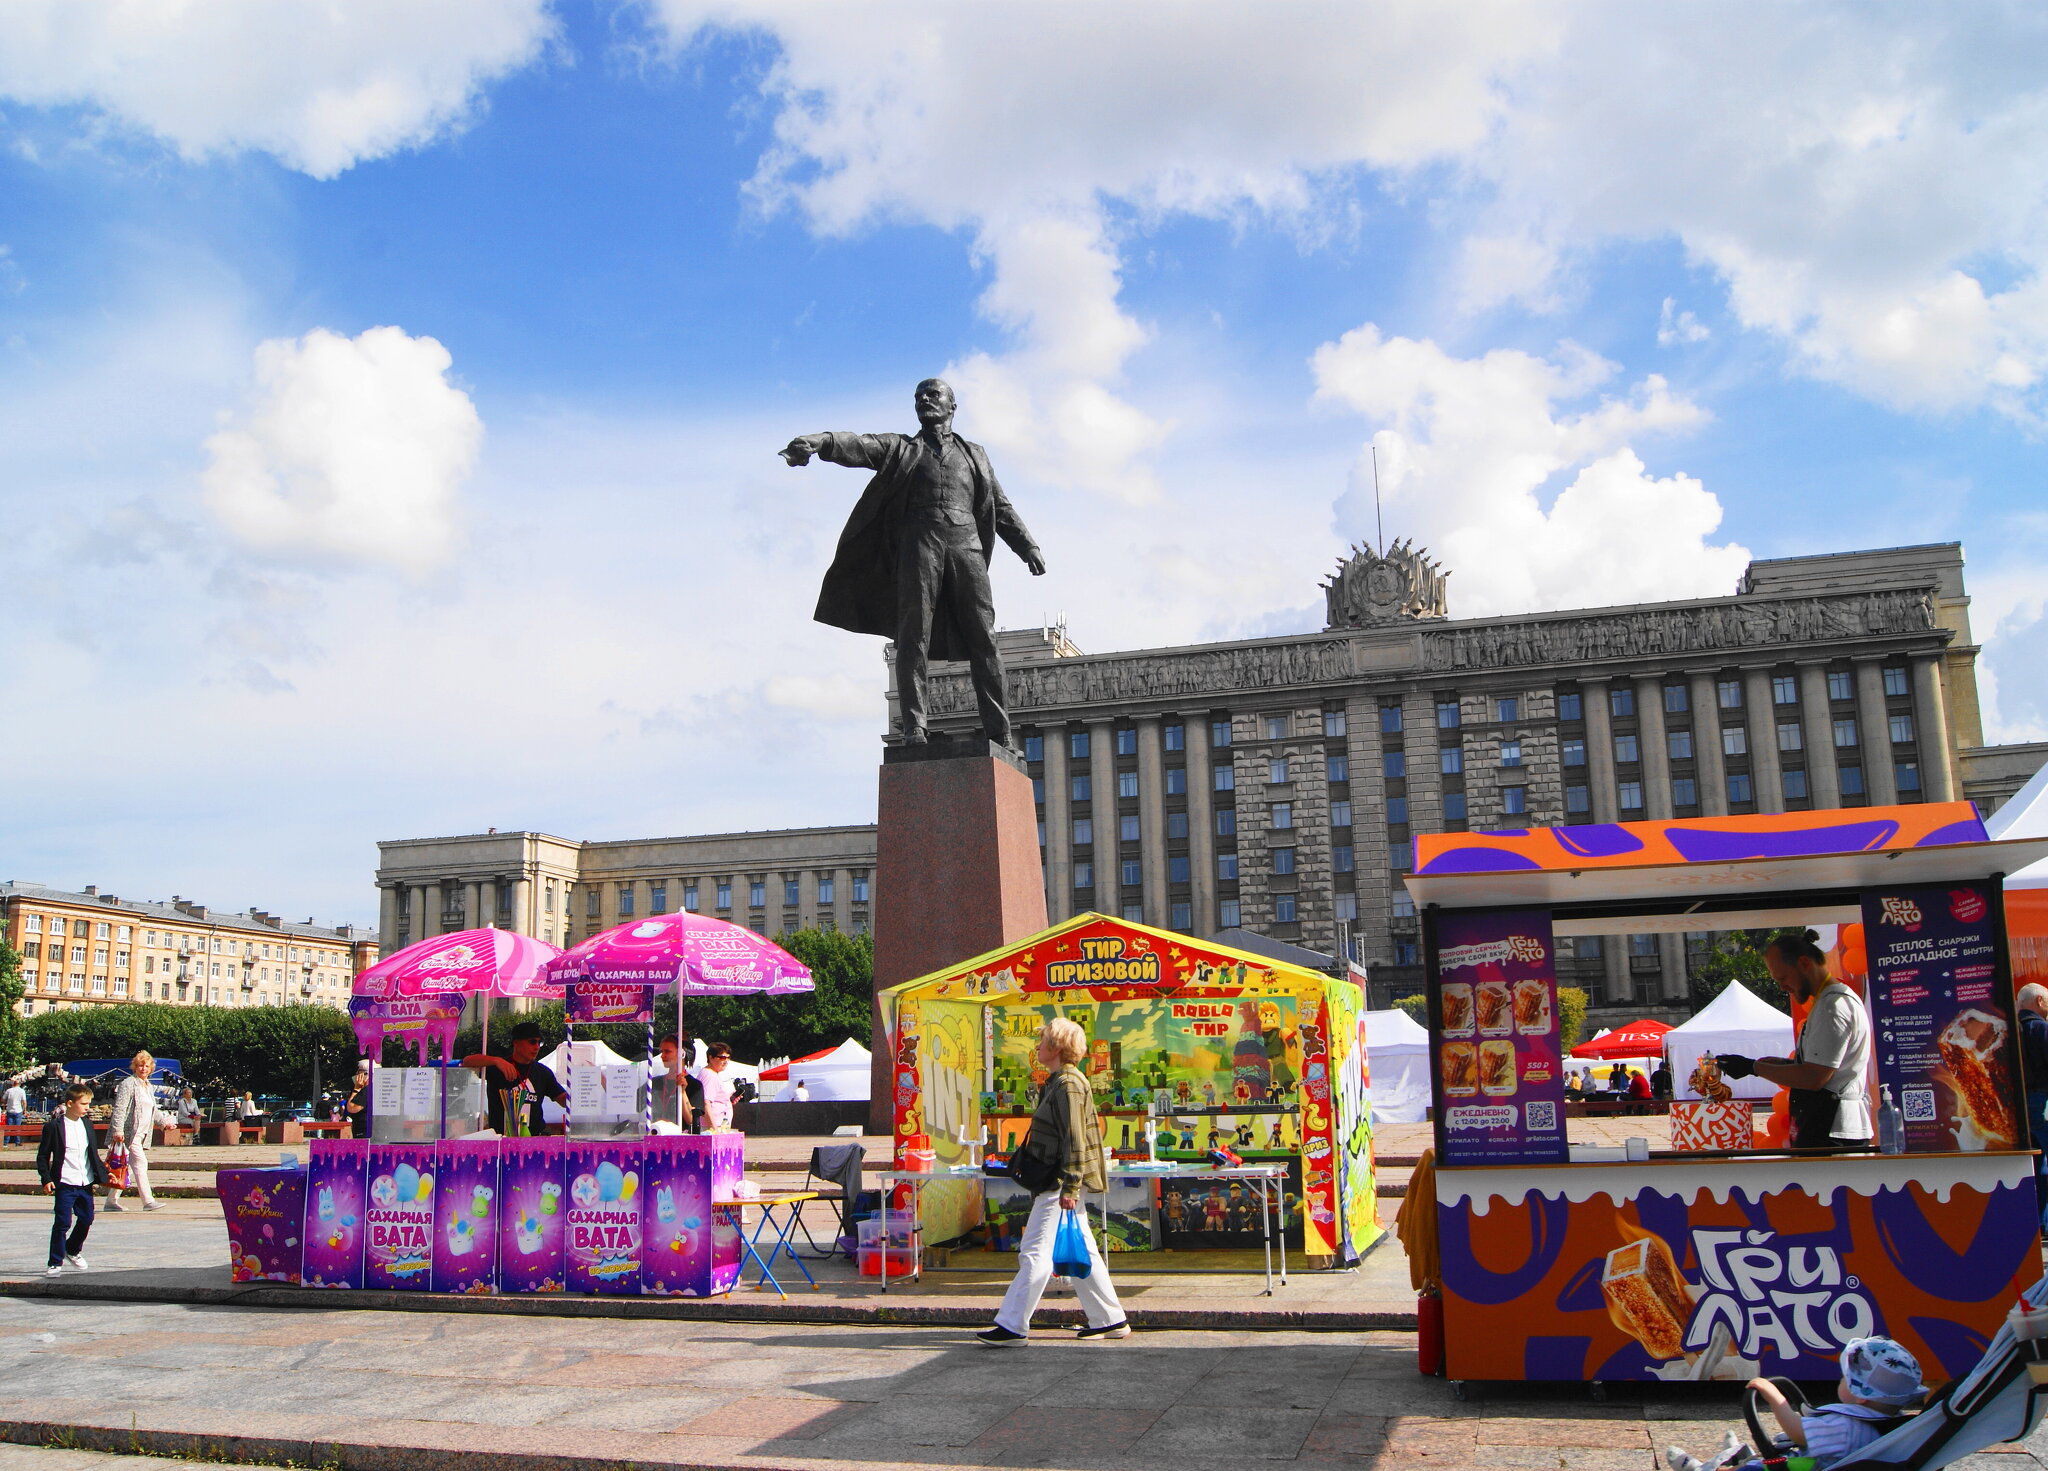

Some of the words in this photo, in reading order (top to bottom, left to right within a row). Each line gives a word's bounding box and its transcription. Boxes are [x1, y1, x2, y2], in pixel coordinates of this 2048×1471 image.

[702, 941, 748, 950] ВАТА
[1083, 940, 1122, 960] ТИР
[1889, 939, 1933, 953] ТЕПЛОЕ
[1938, 935, 1980, 947] СНАРУЖИ
[1490, 950, 1508, 958] ВКУС
[1877, 948, 1958, 967] ПРОХЛАДНОЕ
[1963, 946, 1994, 956] ВНУТРИ
[595, 971, 645, 980] САХАРНАЯ
[648, 970, 672, 979] ВАТА
[1050, 956, 1158, 983] ПРИЗОВОЙ
[575, 982, 643, 994] САХАРНАЯ
[592, 996, 625, 1007] ВАТА
[391, 1003, 422, 1016] ВАТА
[1006, 1015, 1043, 1032] ТИР
[1193, 1023, 1228, 1036] ТИР
[1618, 1031, 1662, 1042] TESS
[1526, 1062, 1542, 1070] 550
[1453, 1108, 1511, 1117] ЕЖЕДНЕВНО
[1303, 1139, 1329, 1154] ПРИЗ
[367, 1209, 433, 1225] САХАРНАЯ
[567, 1210, 638, 1225] САХАРНАЯ
[373, 1225, 428, 1247] ВАТА
[574, 1226, 634, 1249] ВАТА
[1686, 1290, 1874, 1360] ЛАТО
